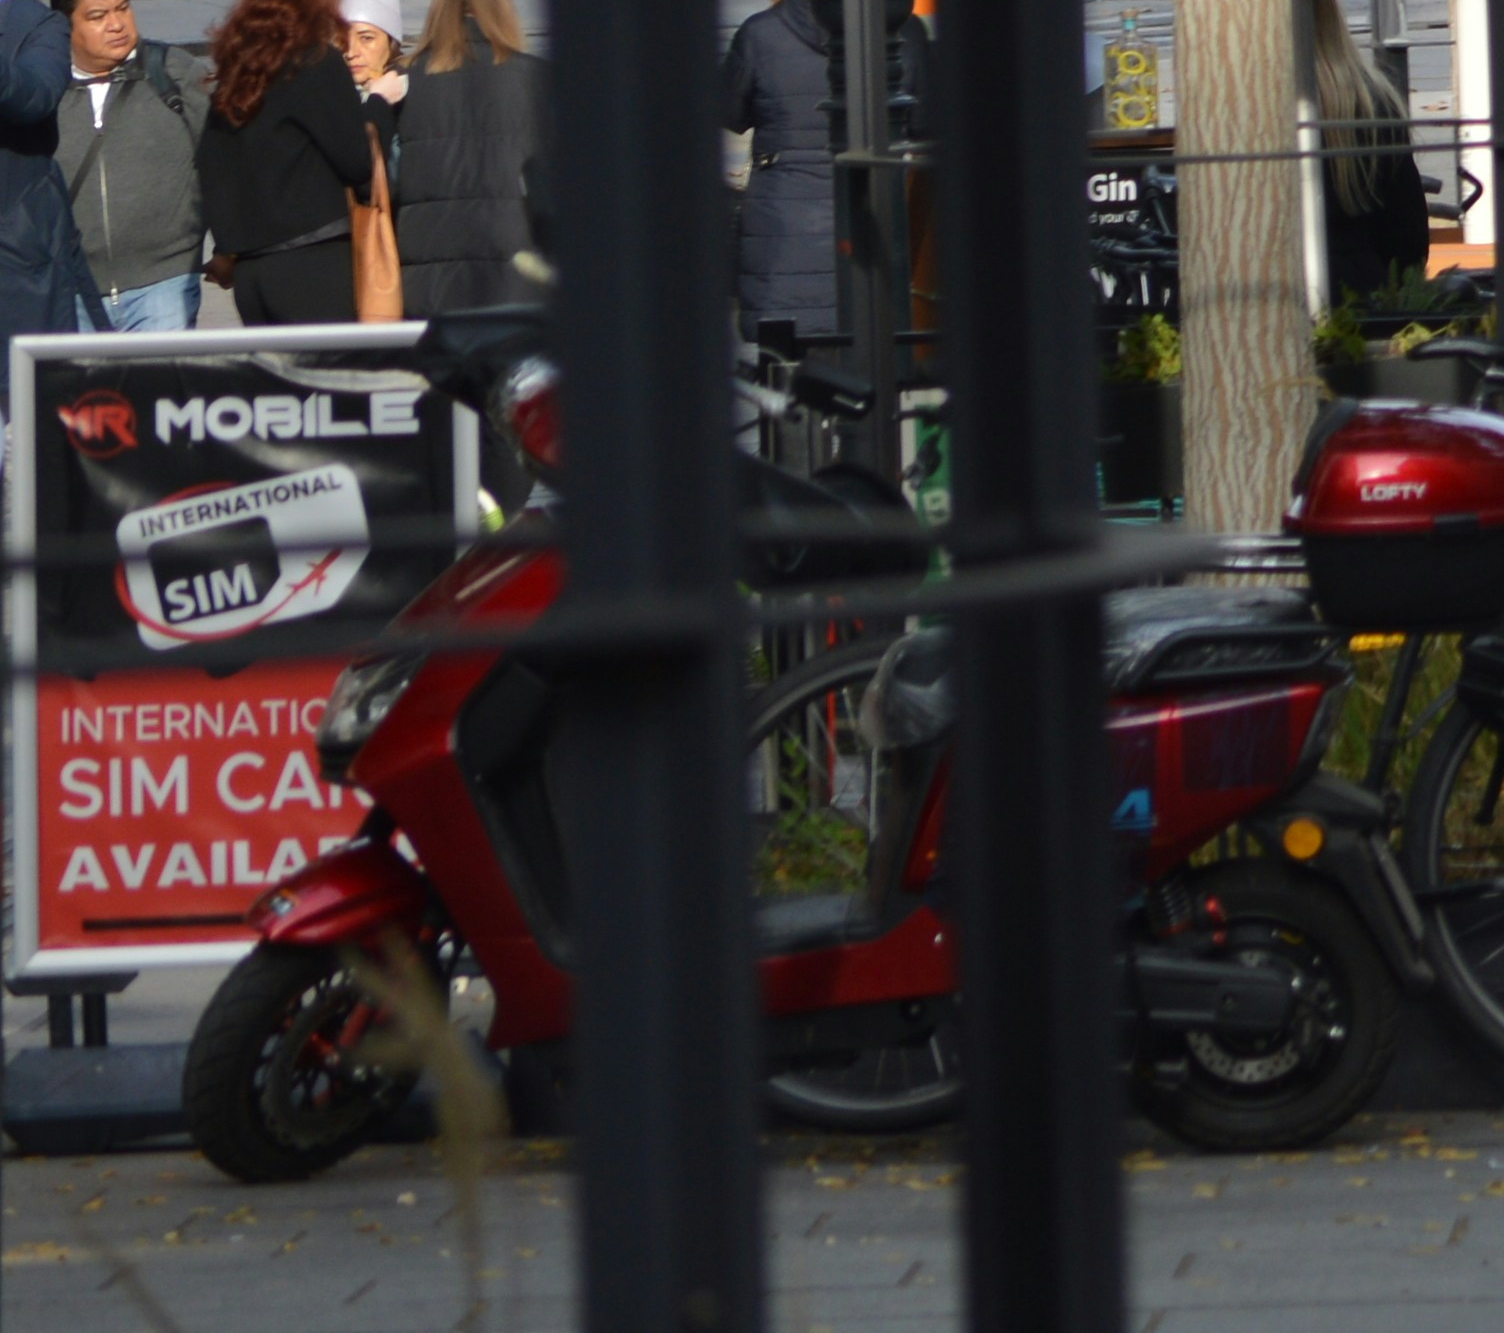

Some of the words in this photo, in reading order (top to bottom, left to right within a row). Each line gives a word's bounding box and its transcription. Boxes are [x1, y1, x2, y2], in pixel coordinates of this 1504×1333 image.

[1087, 171, 1137, 203] Gin
[155, 390, 424, 444] MOBILE
[139, 471, 343, 538] INTERNATIONAL
[164, 563, 257, 621] SIM
[61, 697, 329, 744] INTERNATIO
[59, 754, 190, 820] SIM
[58, 837, 352, 892] AVAILA
